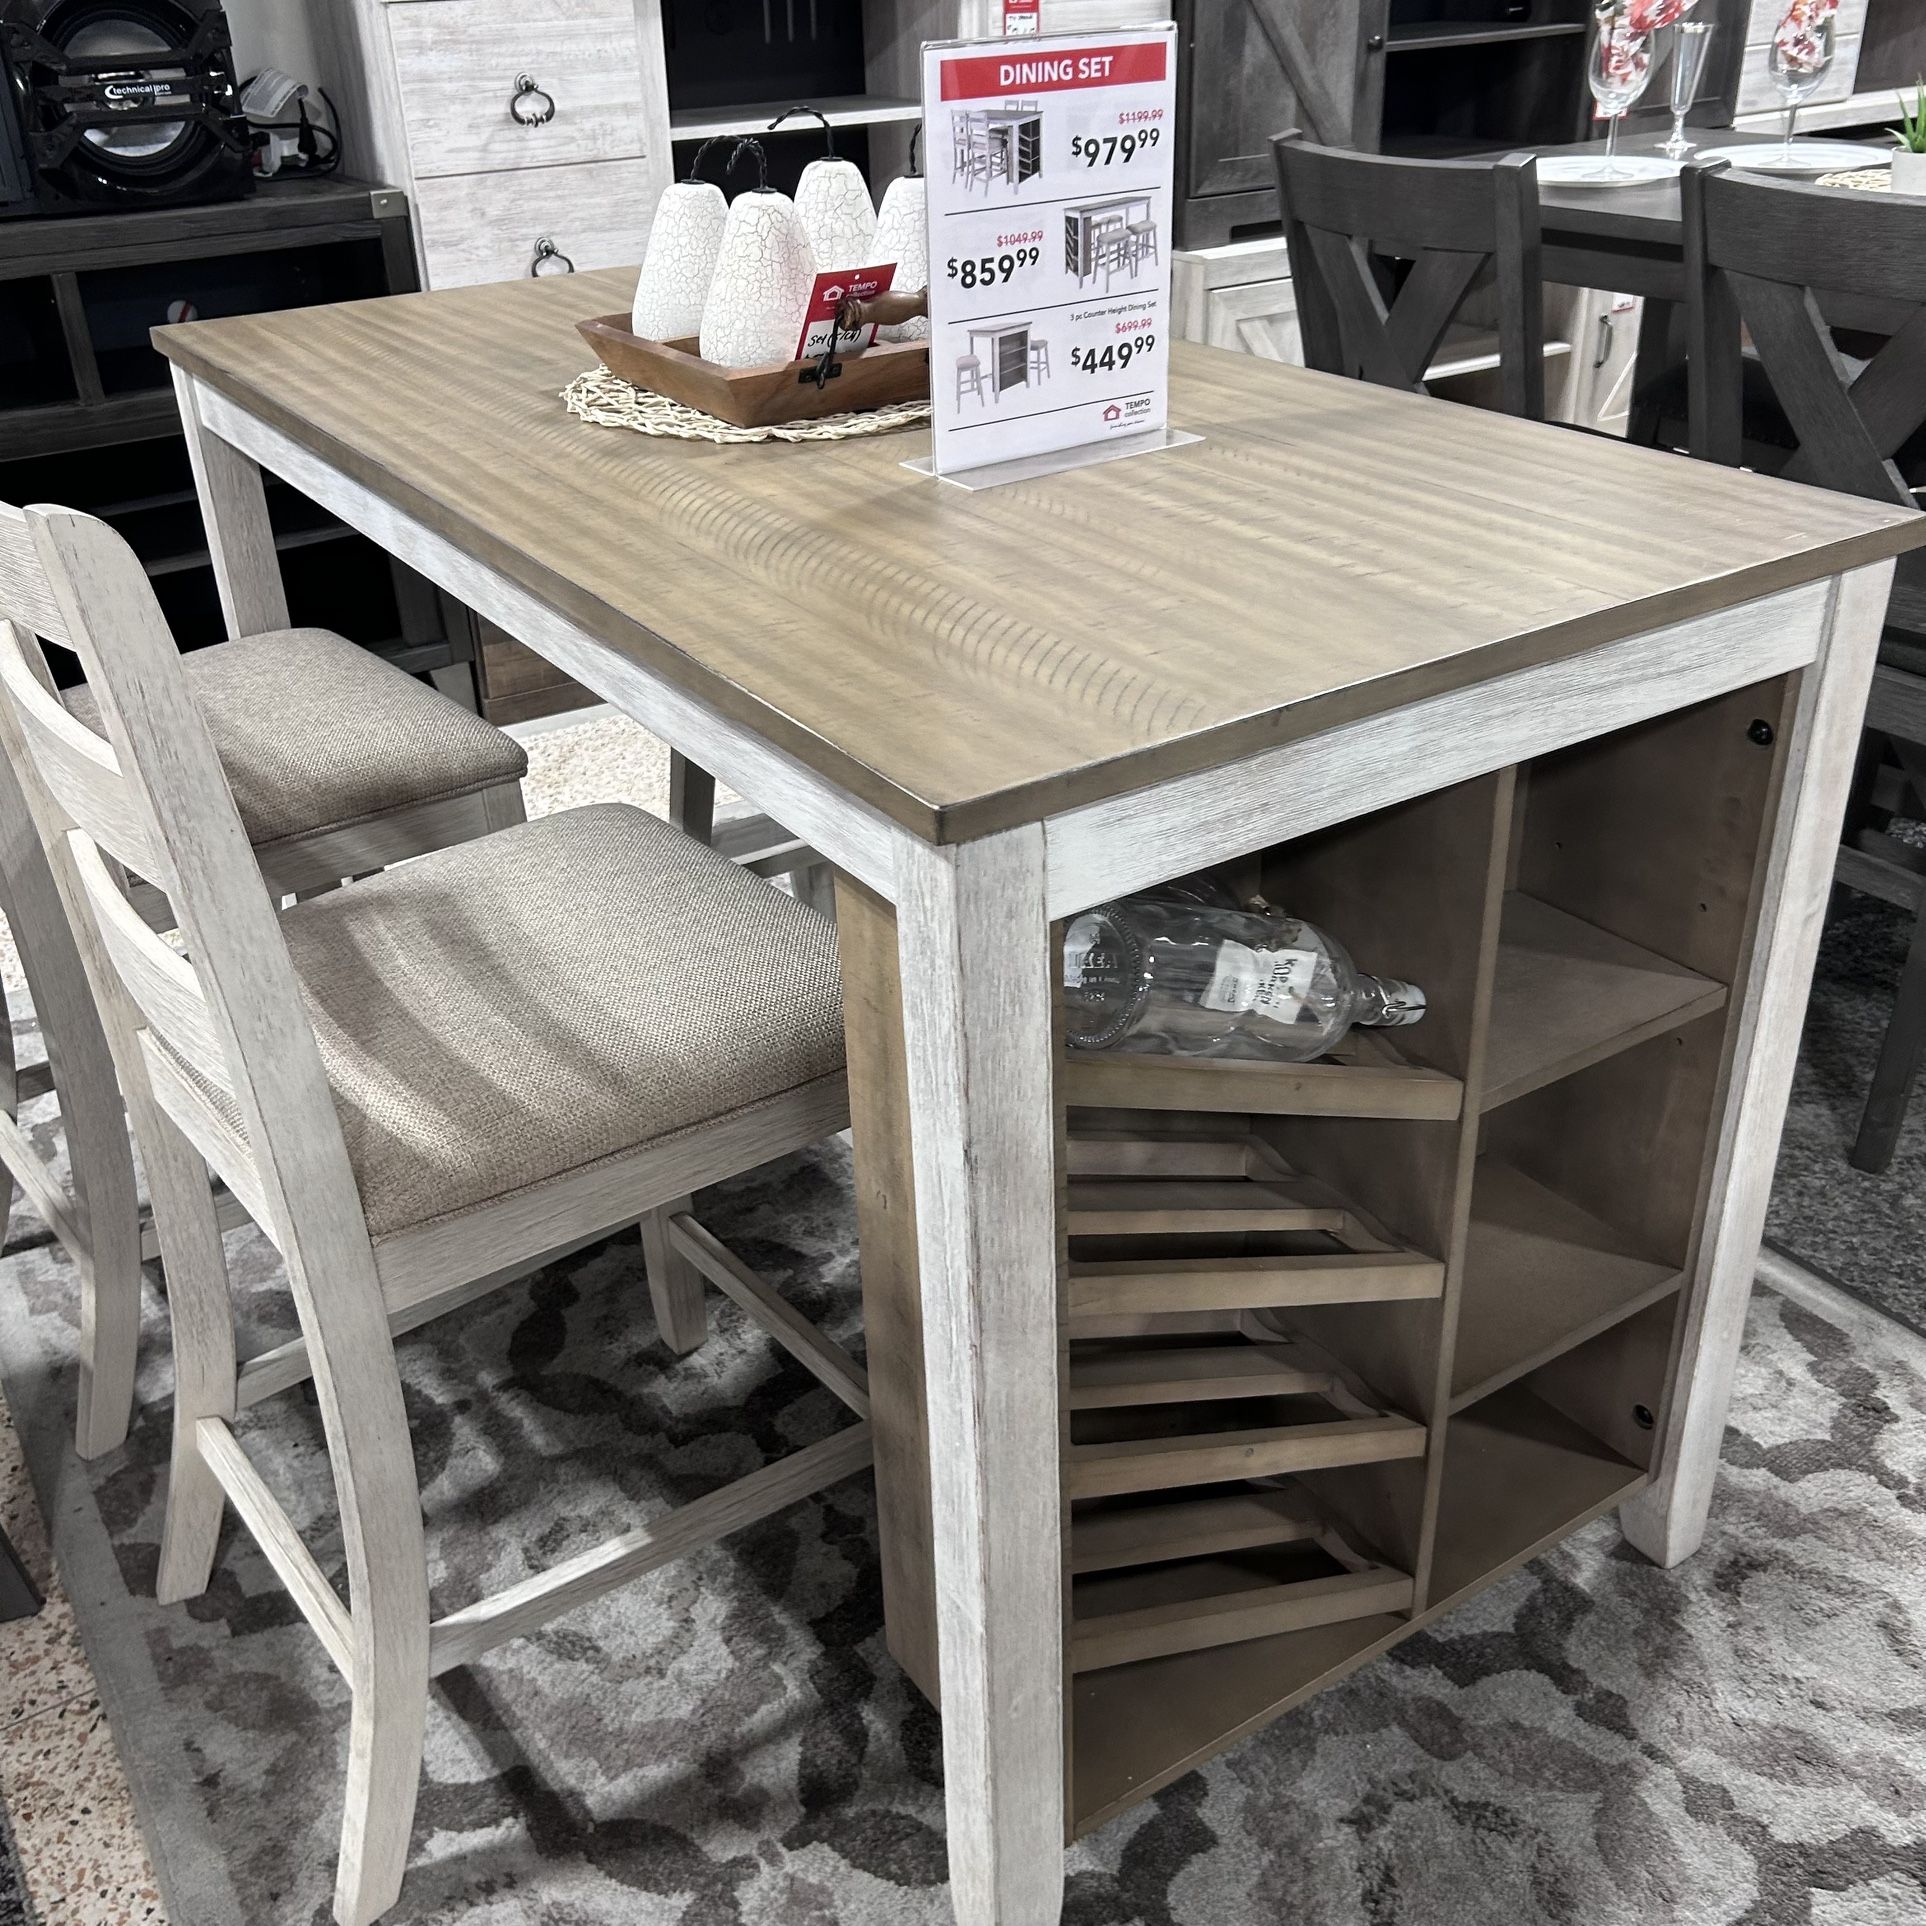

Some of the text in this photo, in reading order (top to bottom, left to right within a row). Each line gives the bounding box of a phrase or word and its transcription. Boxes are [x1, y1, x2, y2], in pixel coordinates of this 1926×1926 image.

[1000, 56, 1113, 86] DINING SET
[112, 85, 153, 95] technical
[156, 84, 171, 93] pro
[1118, 109, 1164, 124] $1199.99
[996, 230, 1044, 247] $1049.99
[848, 281, 878, 292] TEMPO
[1070, 313, 1074, 321] 3
[1083, 310, 1107, 319] Counter
[1107, 306, 1127, 315] Height
[1128, 303, 1147, 312] Dining
[1147, 300, 1157, 308] Set
[1115, 317, 1152, 334] $699.99
[1125, 398, 1151, 410] TEMPO
[1124, 408, 1151, 417] collection
